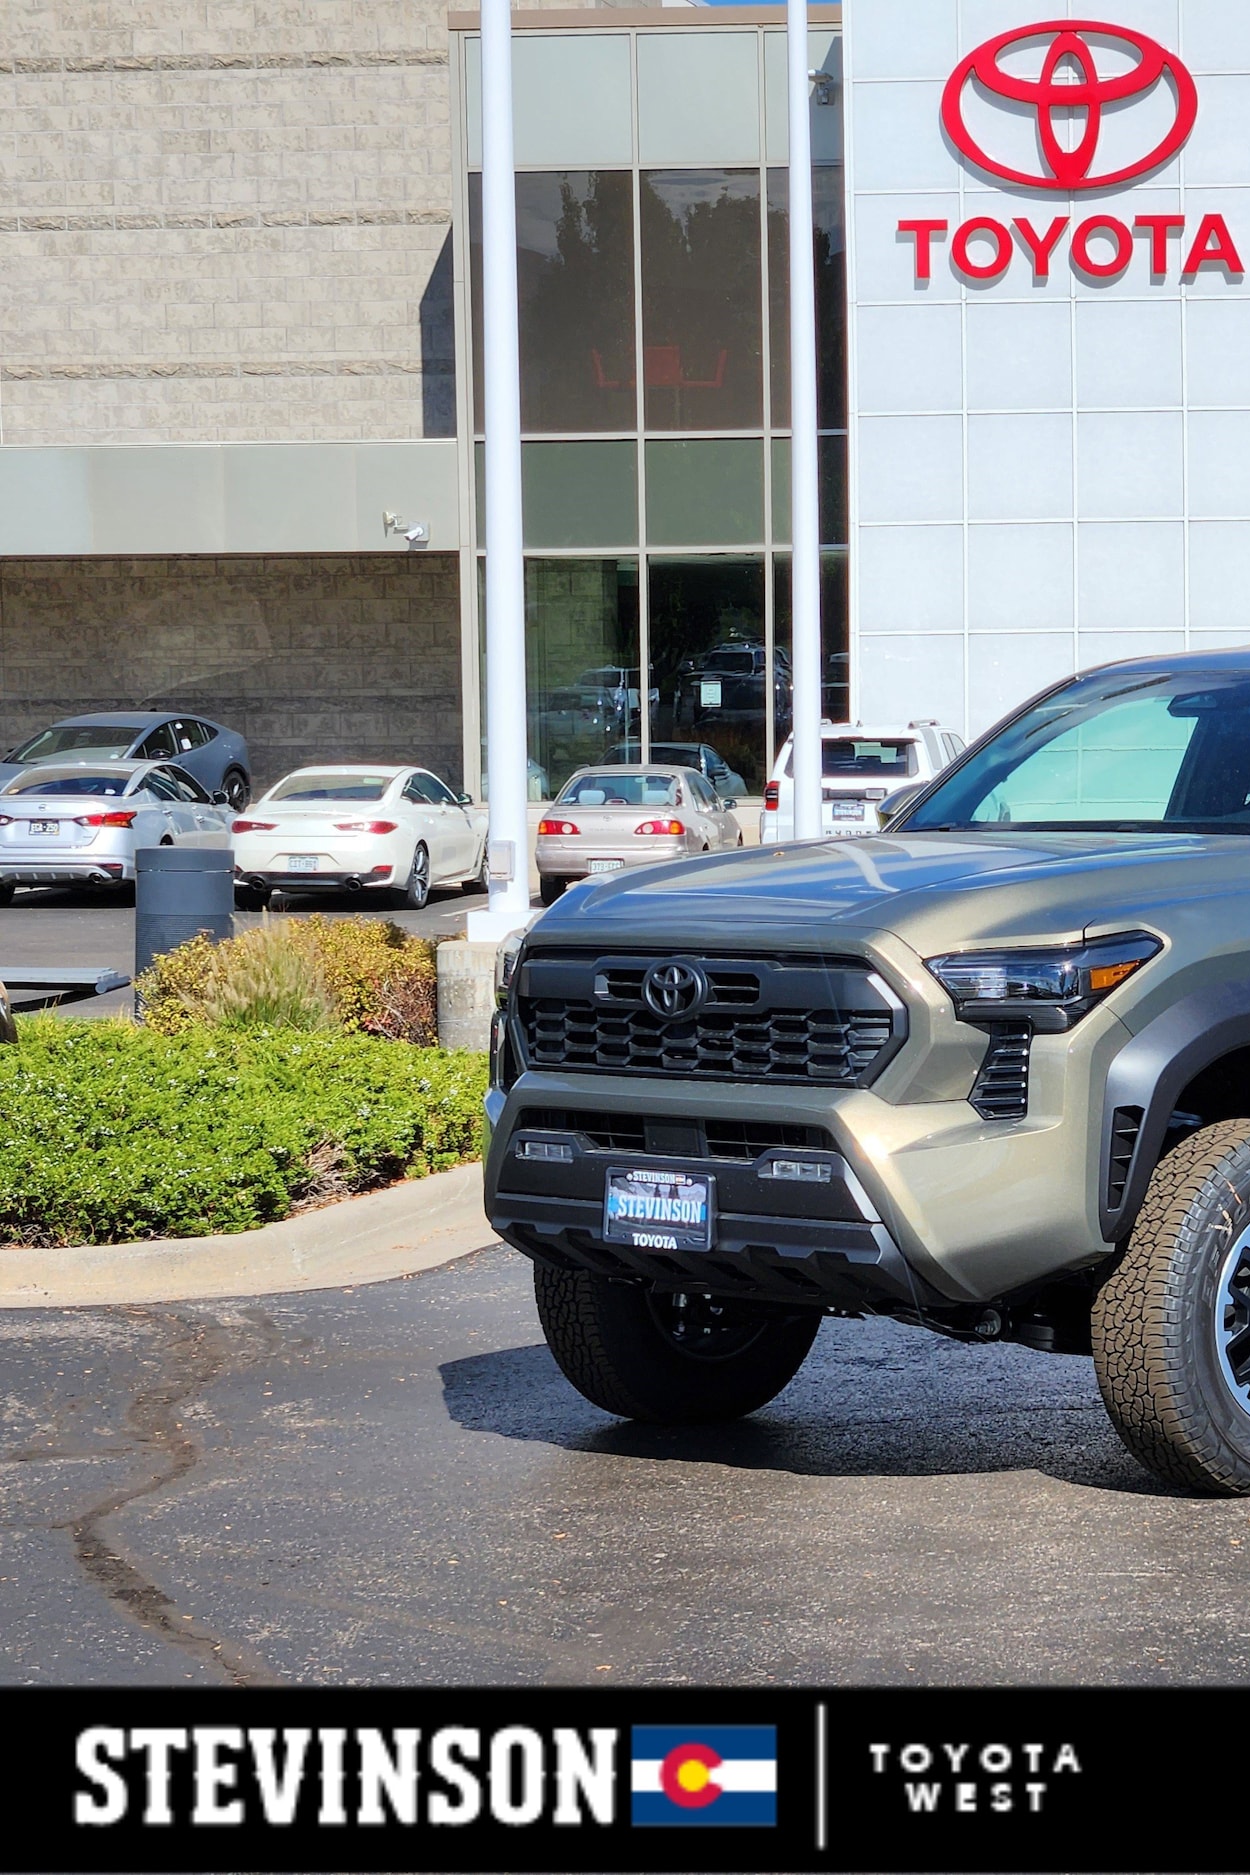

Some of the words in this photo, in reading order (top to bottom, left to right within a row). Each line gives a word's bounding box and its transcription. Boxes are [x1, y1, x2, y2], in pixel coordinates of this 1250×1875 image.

[897, 213, 1244, 279] TOYOTA
[632, 1170, 676, 1184] STEVINSON
[617, 1194, 702, 1224] STEVINSON
[632, 1233, 678, 1250] TOYOTA
